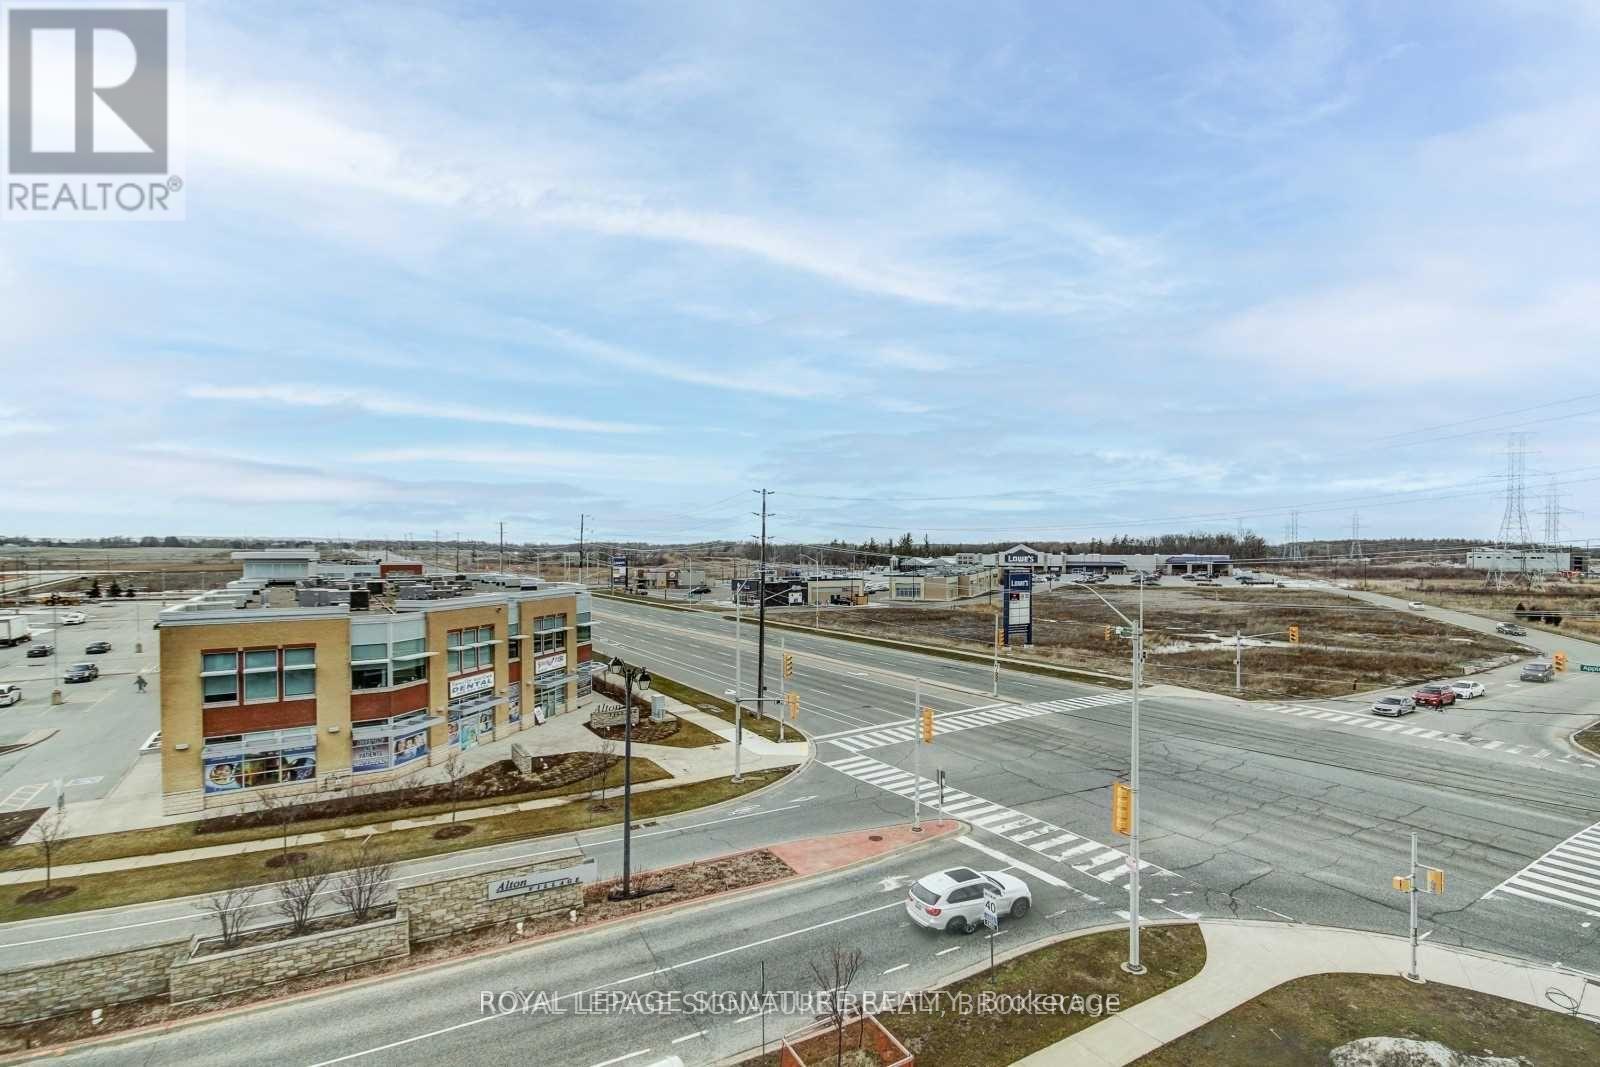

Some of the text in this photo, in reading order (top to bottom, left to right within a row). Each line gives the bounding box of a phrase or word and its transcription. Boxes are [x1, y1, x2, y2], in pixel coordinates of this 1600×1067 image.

[452, 678, 492, 693] DENTAL
[496, 879, 527, 893] Alton
[985, 900, 996, 914] 40
